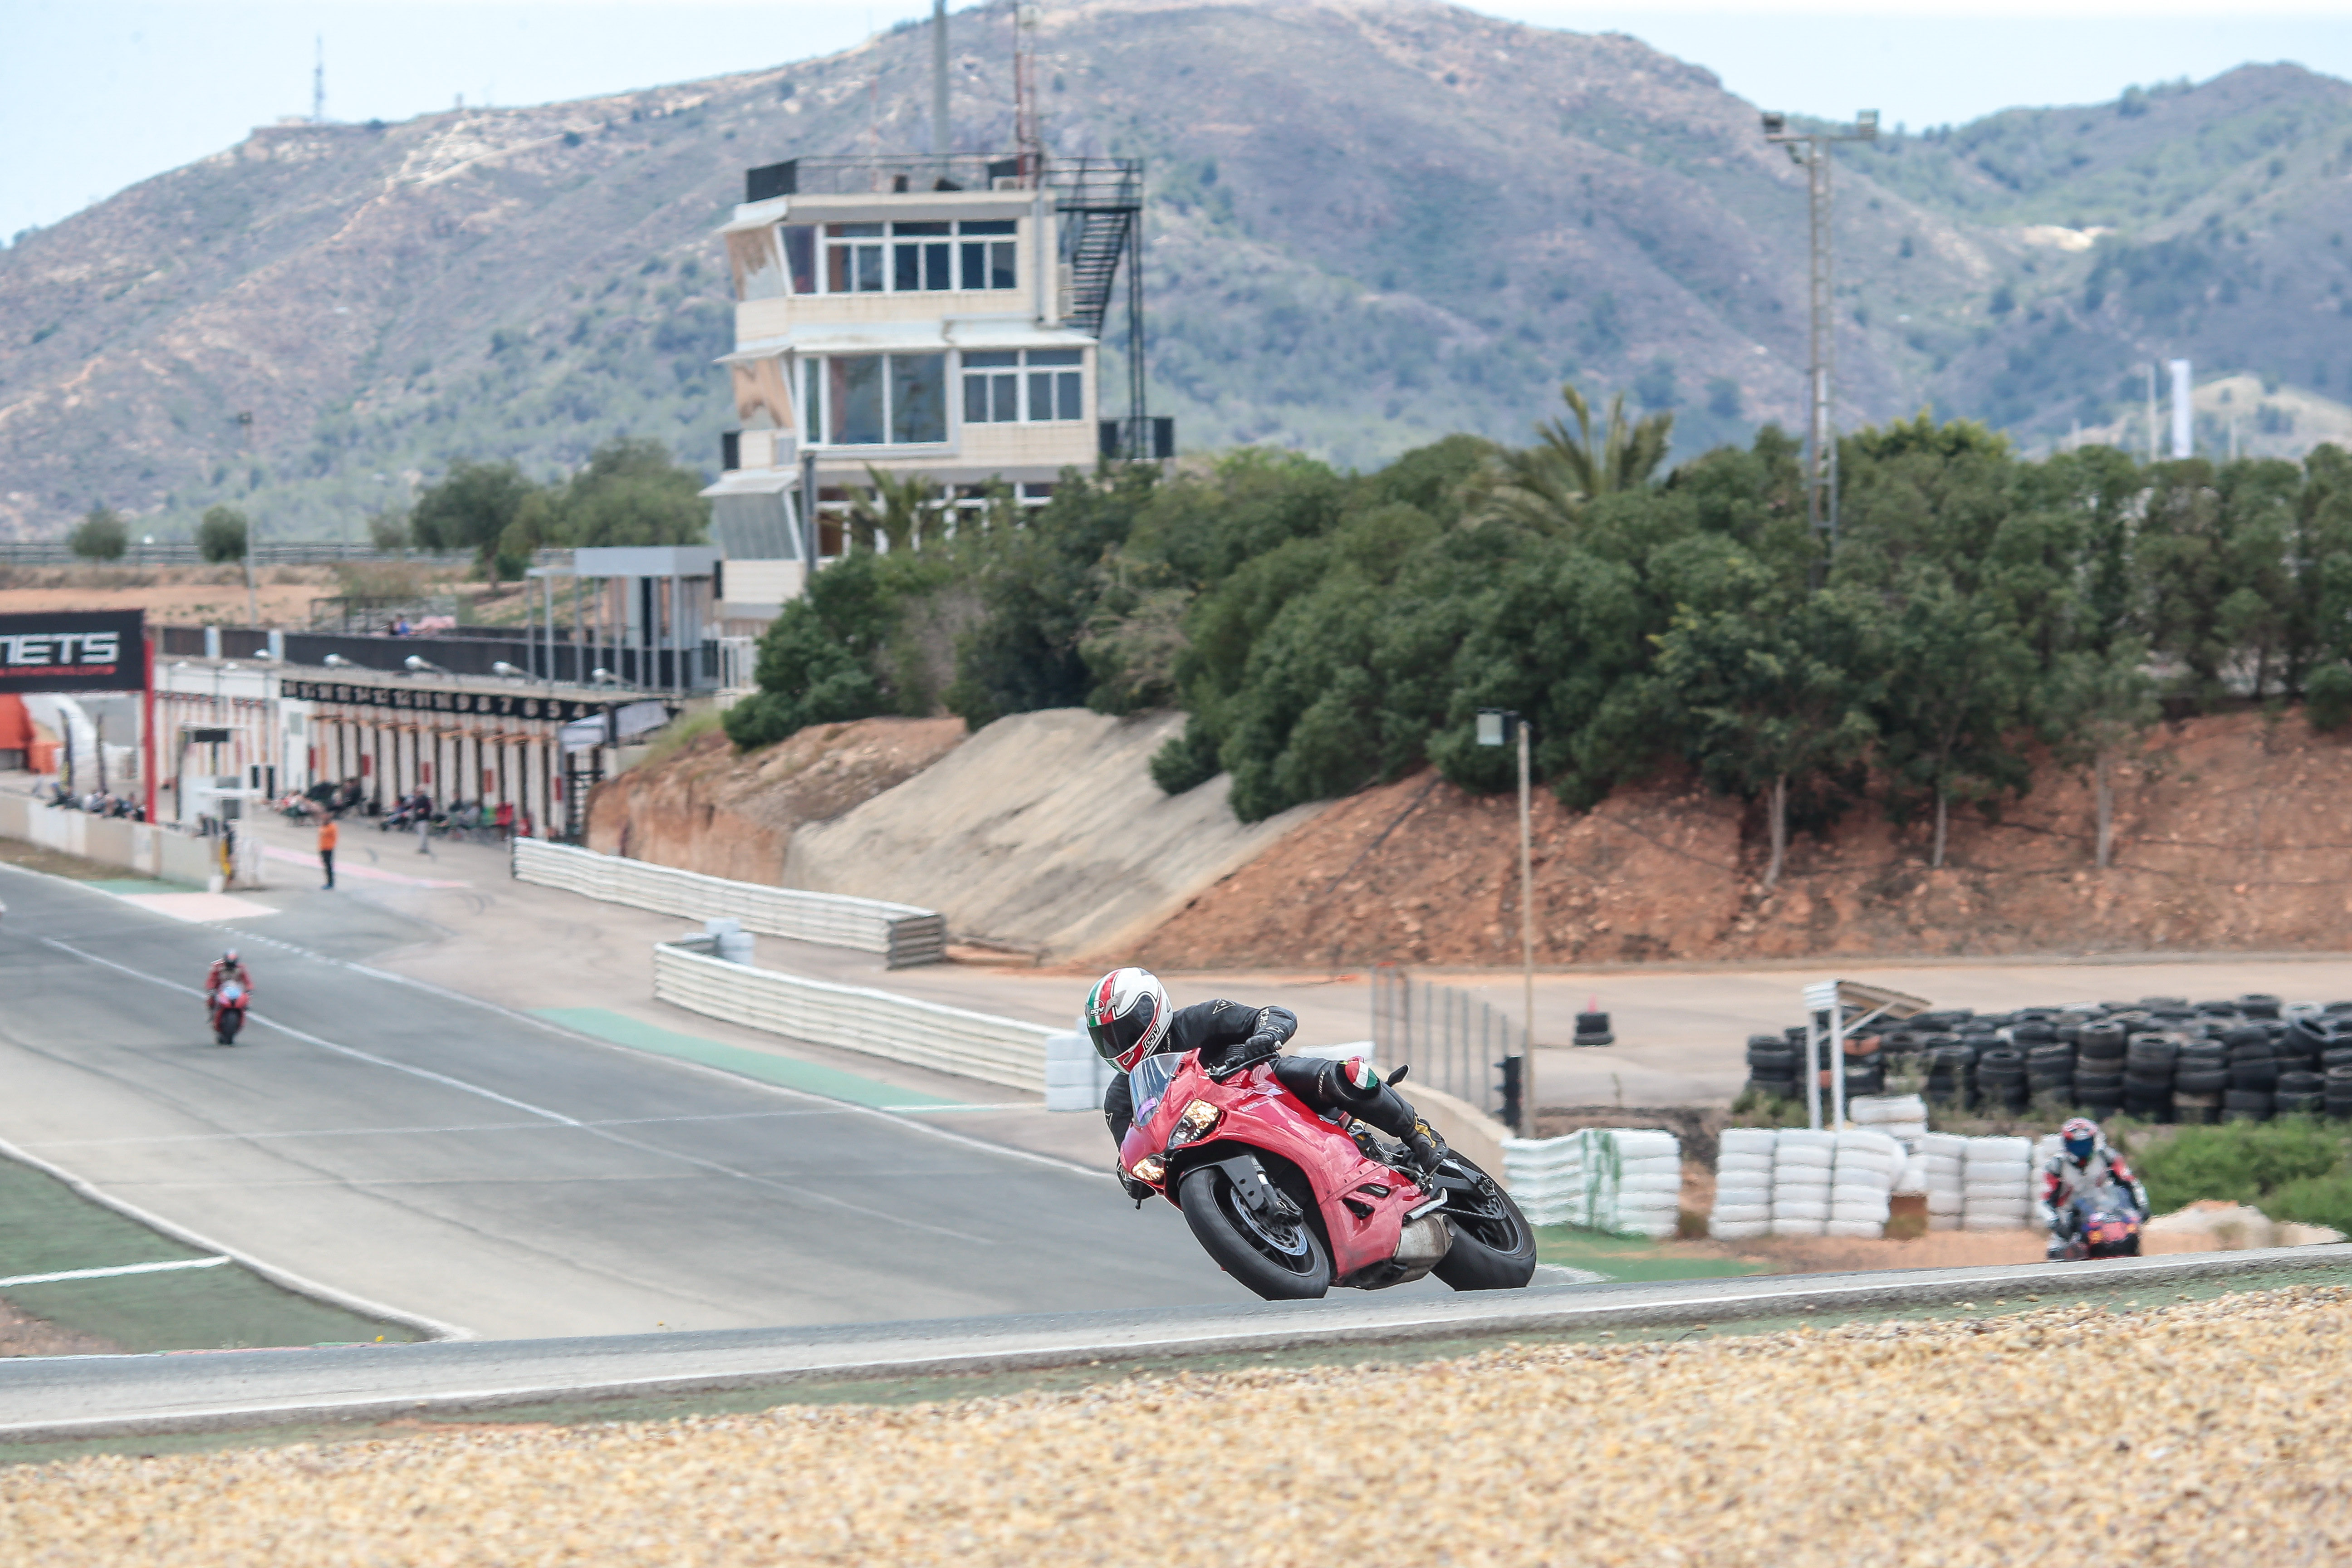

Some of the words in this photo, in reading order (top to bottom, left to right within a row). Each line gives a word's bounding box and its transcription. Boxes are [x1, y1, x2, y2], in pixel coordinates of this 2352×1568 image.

[500, 697, 513, 714] 7
[547, 701, 561, 718] 5
[572, 704, 586, 719] 4
[1090, 1006, 1104, 1016] agv
[1144, 1024, 1159, 1049] agv
